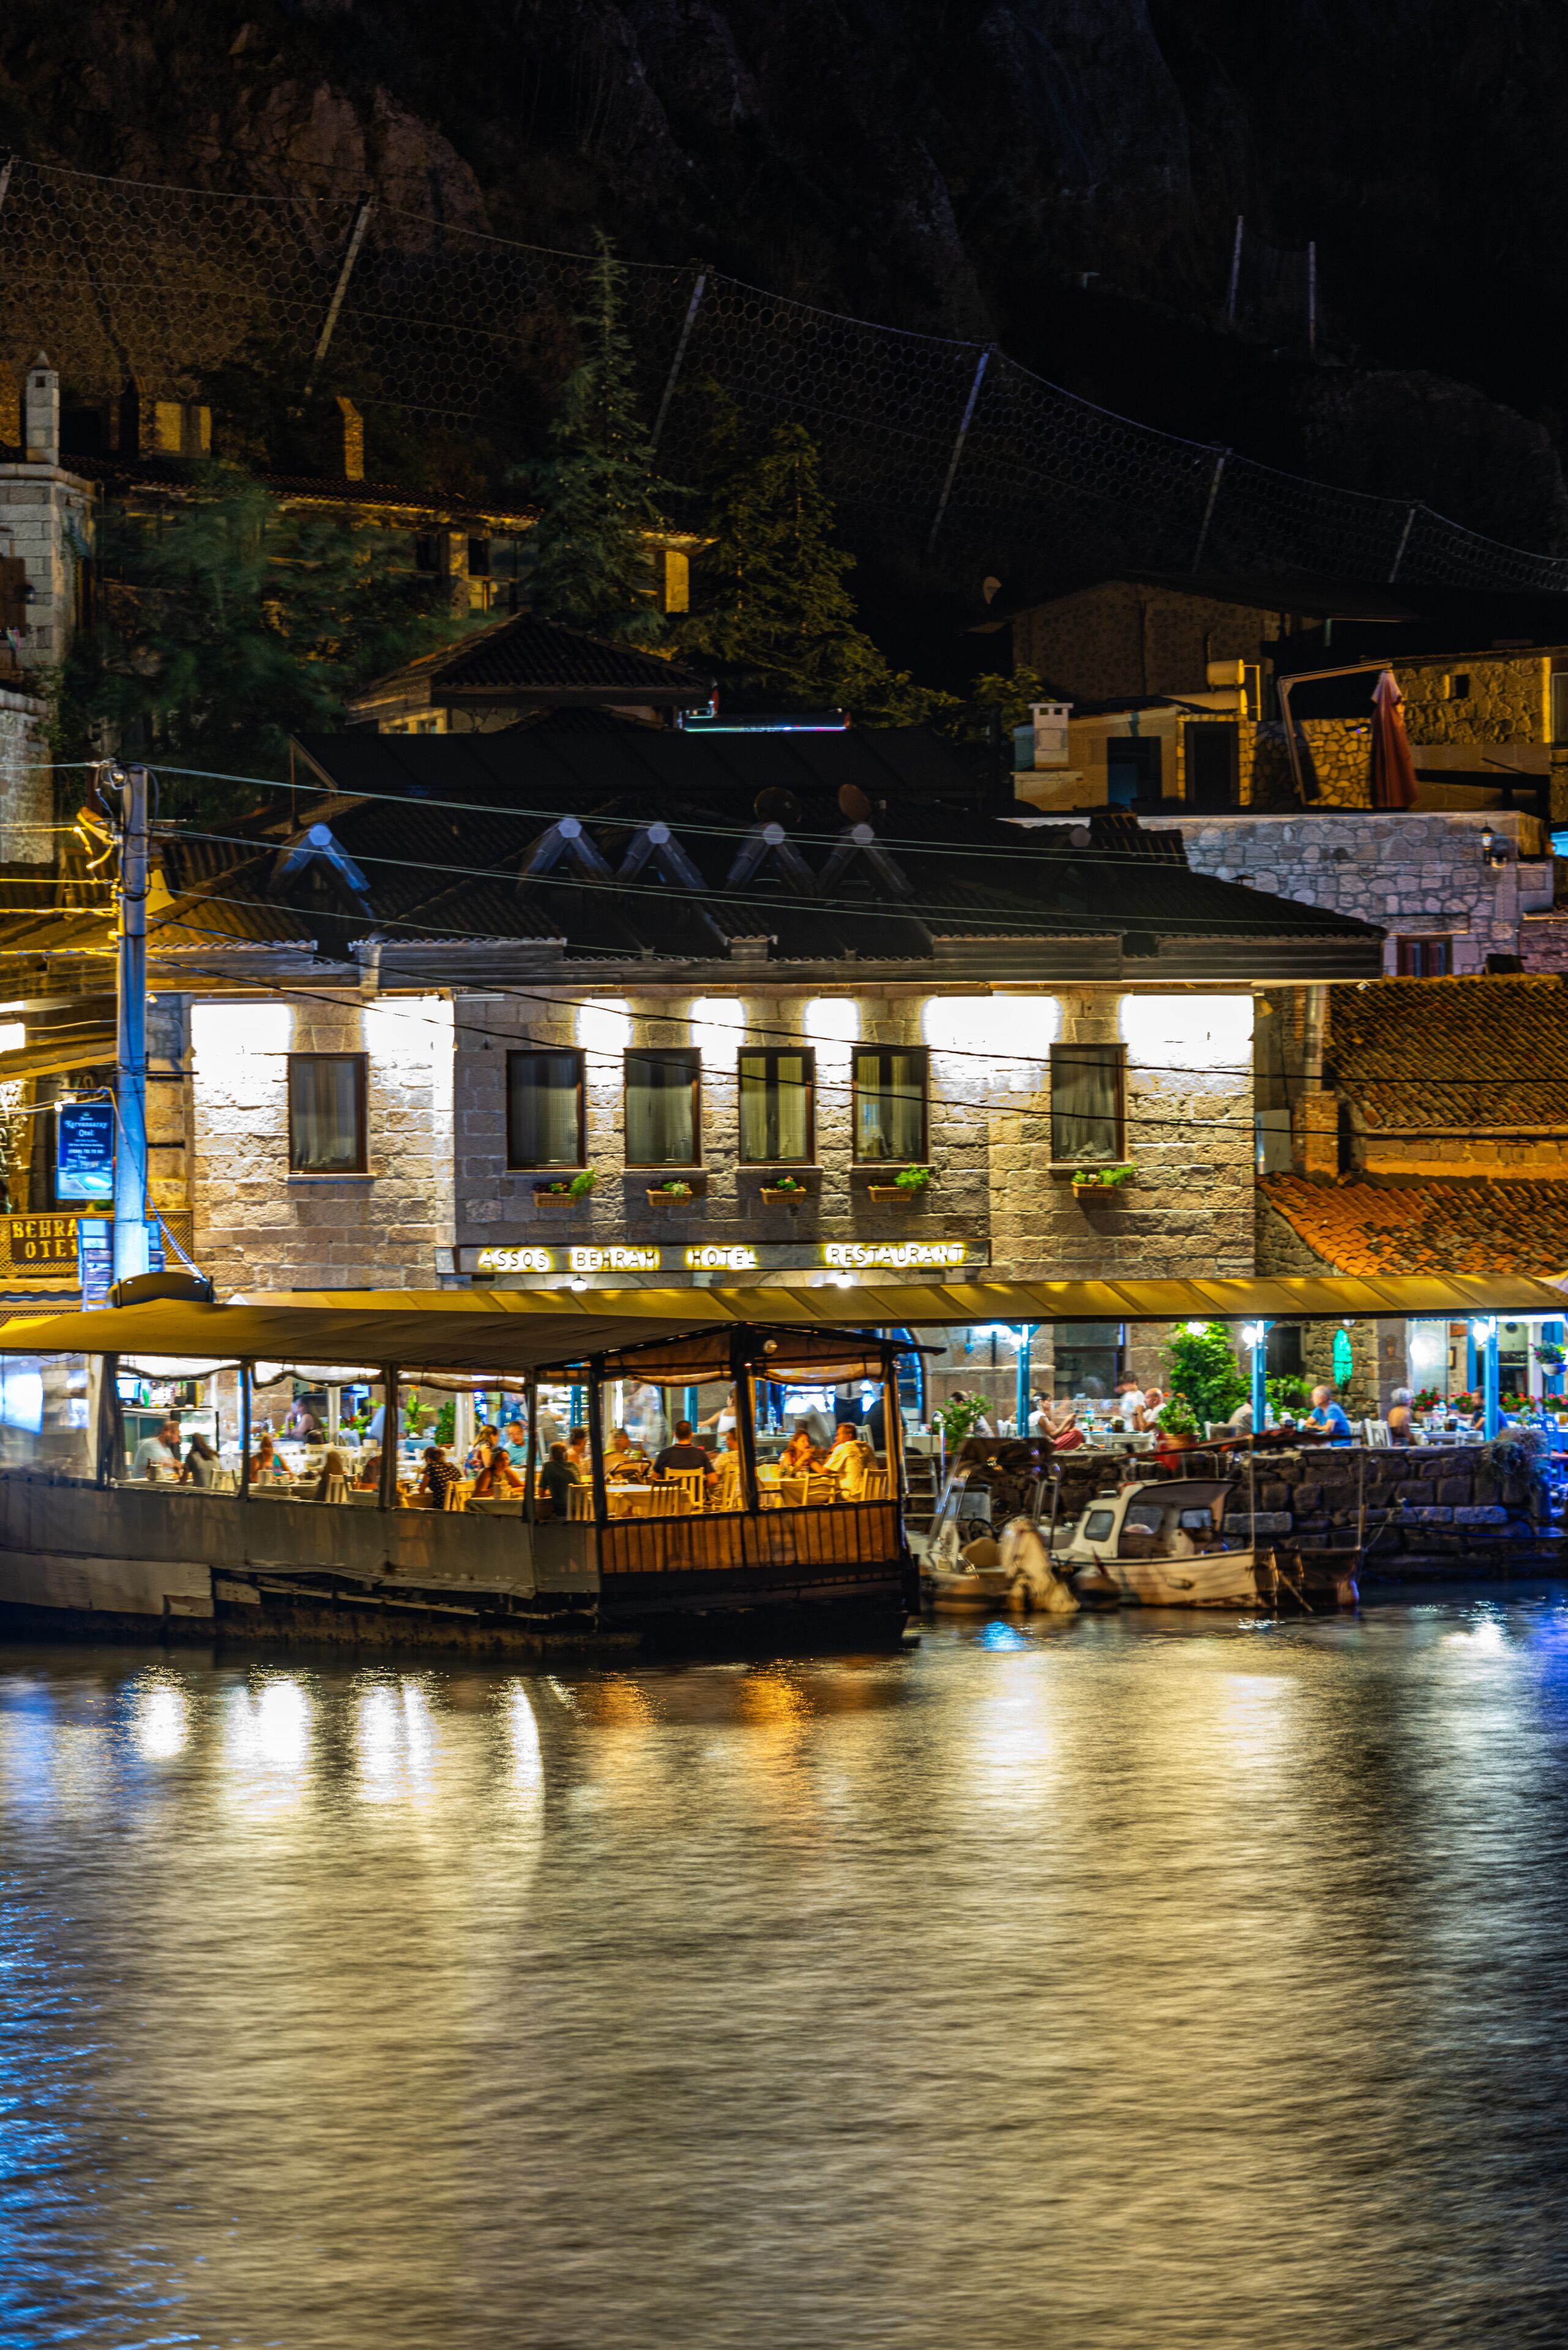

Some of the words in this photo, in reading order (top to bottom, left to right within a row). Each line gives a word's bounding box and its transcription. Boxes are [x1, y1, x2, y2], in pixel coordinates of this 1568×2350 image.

[12, 1218, 79, 1238] BEHRA
[479, 1250, 549, 1269] ASSOS
[574, 1249, 659, 1269] BEHRAM
[687, 1247, 757, 1268] HOTEL
[827, 1245, 965, 1266] RESTAURANT
